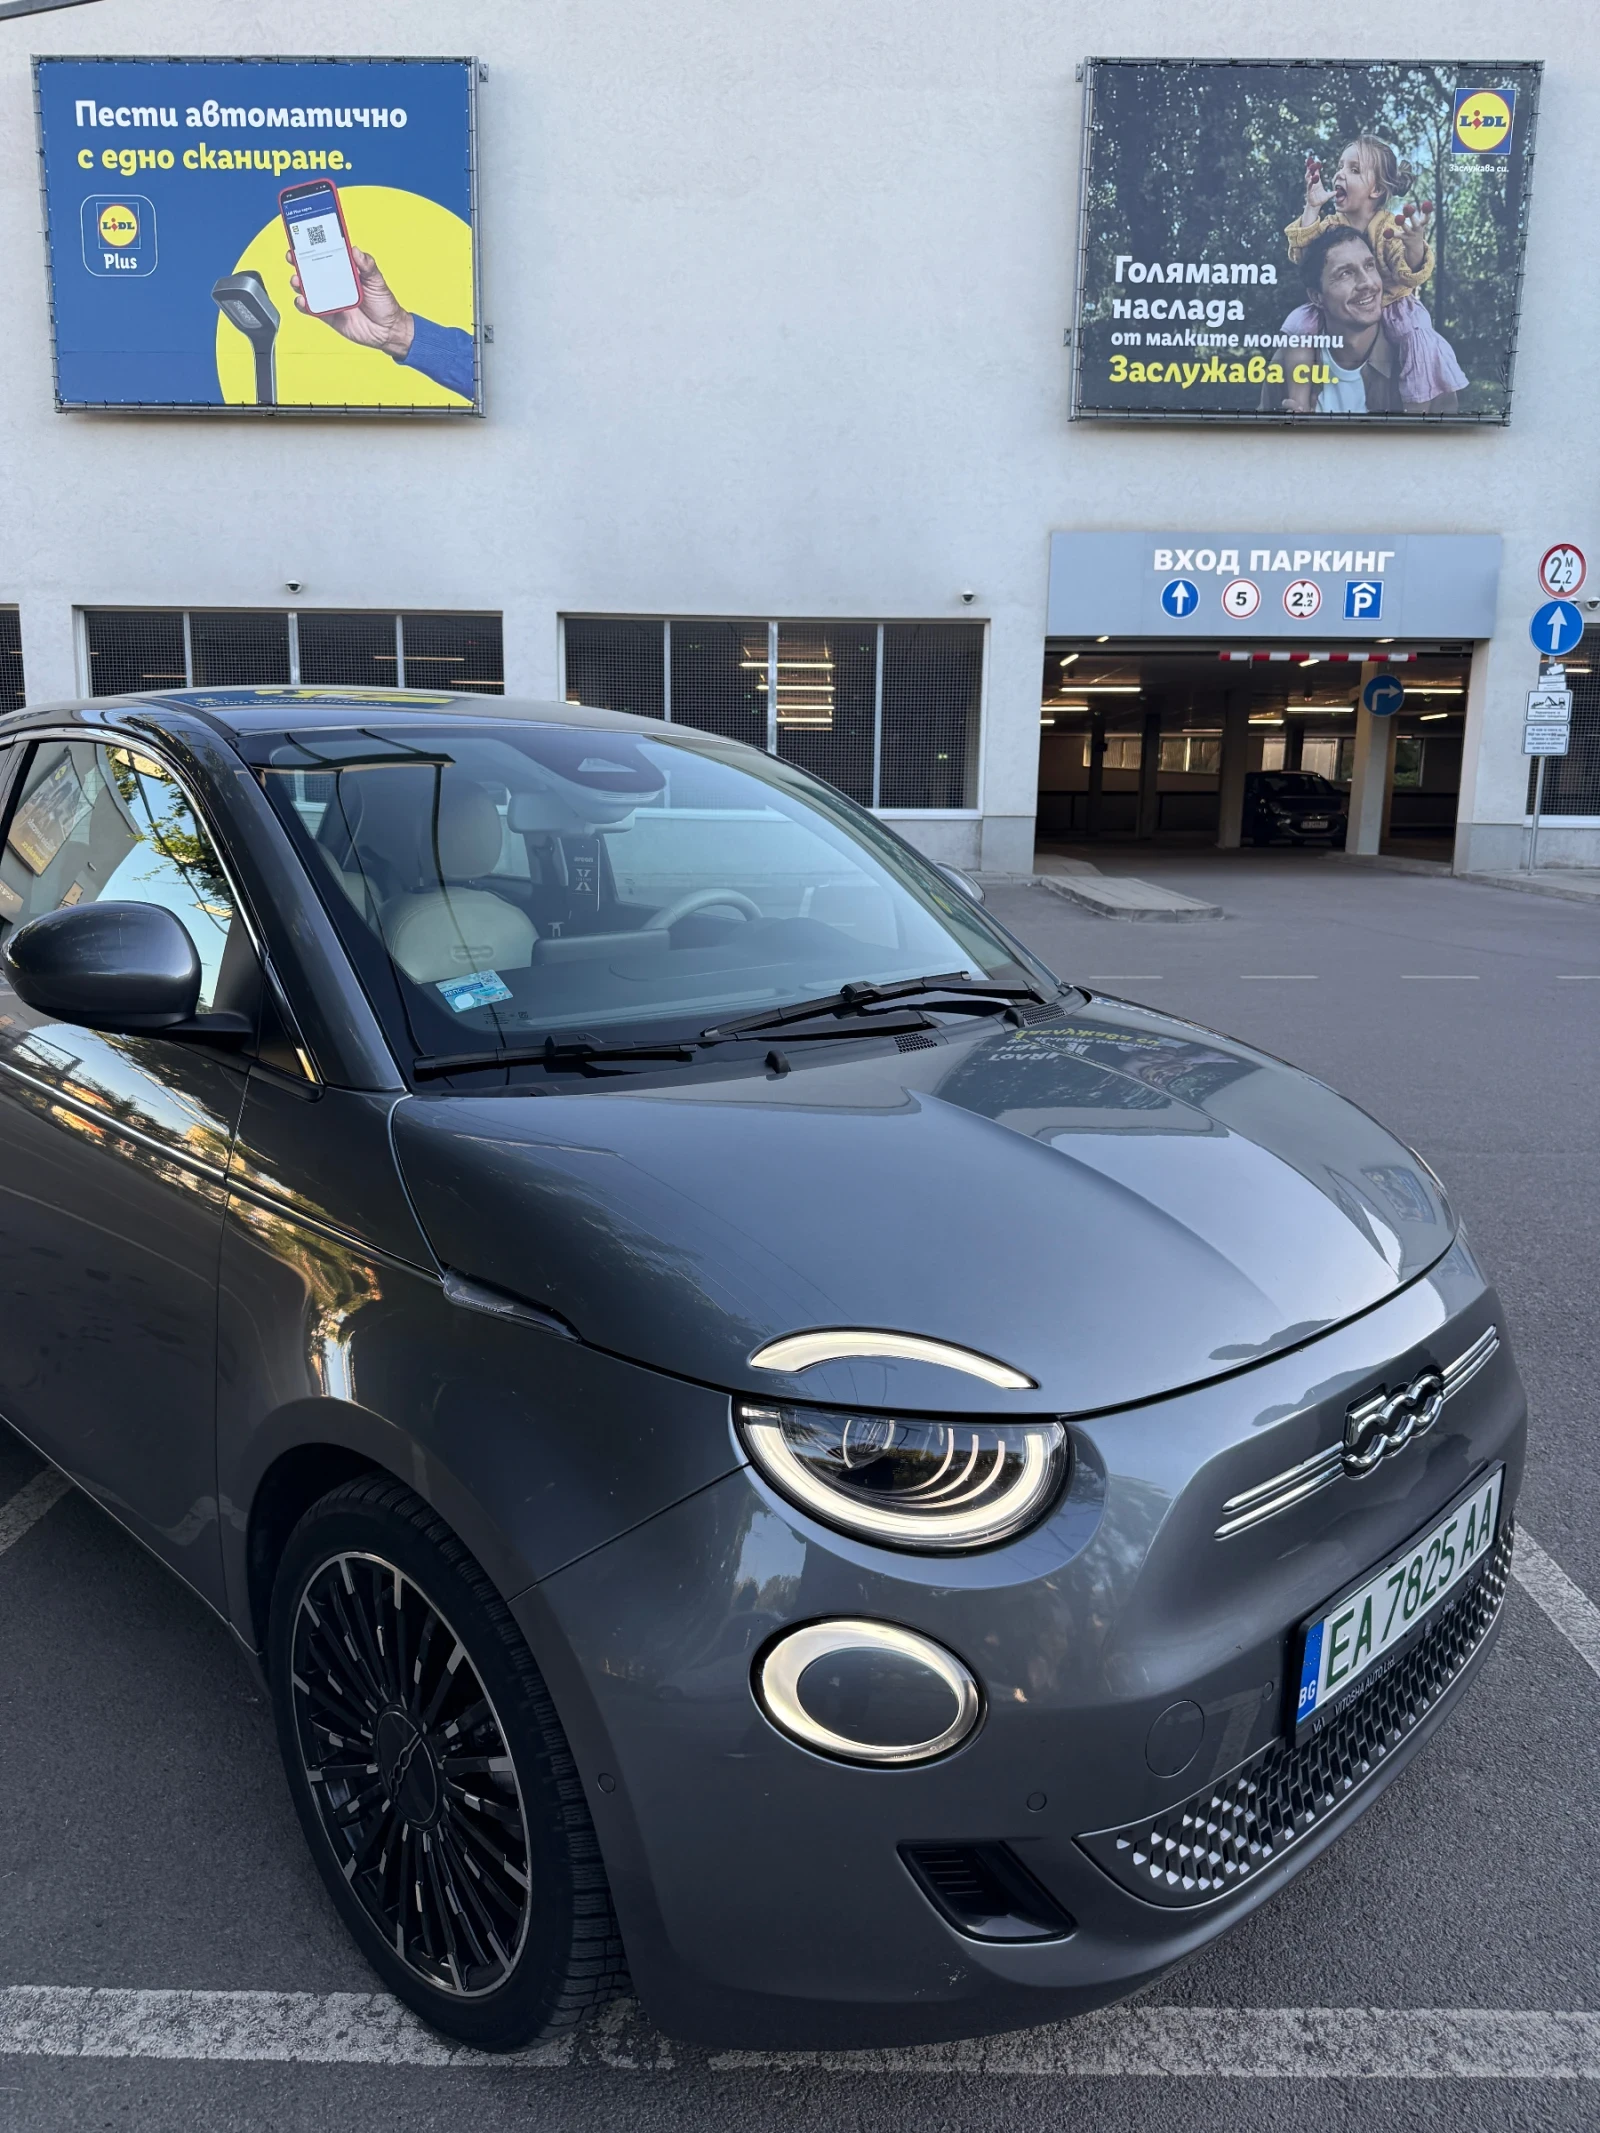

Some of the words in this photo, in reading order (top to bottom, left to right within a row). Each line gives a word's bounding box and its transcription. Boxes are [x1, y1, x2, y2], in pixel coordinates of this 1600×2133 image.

[75, 100, 177, 127] Пести
[185, 99, 408, 128] автоматично
[77, 149, 94, 169] с
[101, 148, 175, 176] едно
[183, 142, 352, 176] сканиране.
[1448, 163, 1495, 174] Заслужава
[103, 253, 138, 269] Plus
[1115, 255, 1278, 285] Голямата
[1112, 298, 1245, 328] наслада
[1111, 332, 1141, 346] от
[1146, 328, 1239, 347] малките
[1243, 334, 1344, 349] моменти
[1108, 354, 1285, 390] Заслужава
[1292, 363, 1339, 385] си.
[1153, 549, 1240, 576] ВХОД
[1249, 549, 1396, 573] ПАРКИНГ
[1235, 591, 1247, 606] 5
[1353, 592, 1373, 617] P
[1344, 1373, 1443, 1468] 500
[1324, 1592, 1373, 1691] EA
[1379, 1518, 1458, 1644] 7825
[1459, 1484, 1493, 1569] AA
[1298, 1679, 1316, 1709] BG
[1334, 1682, 1365, 1716] VITOSHA
[1364, 1666, 1383, 1691] AUTO
